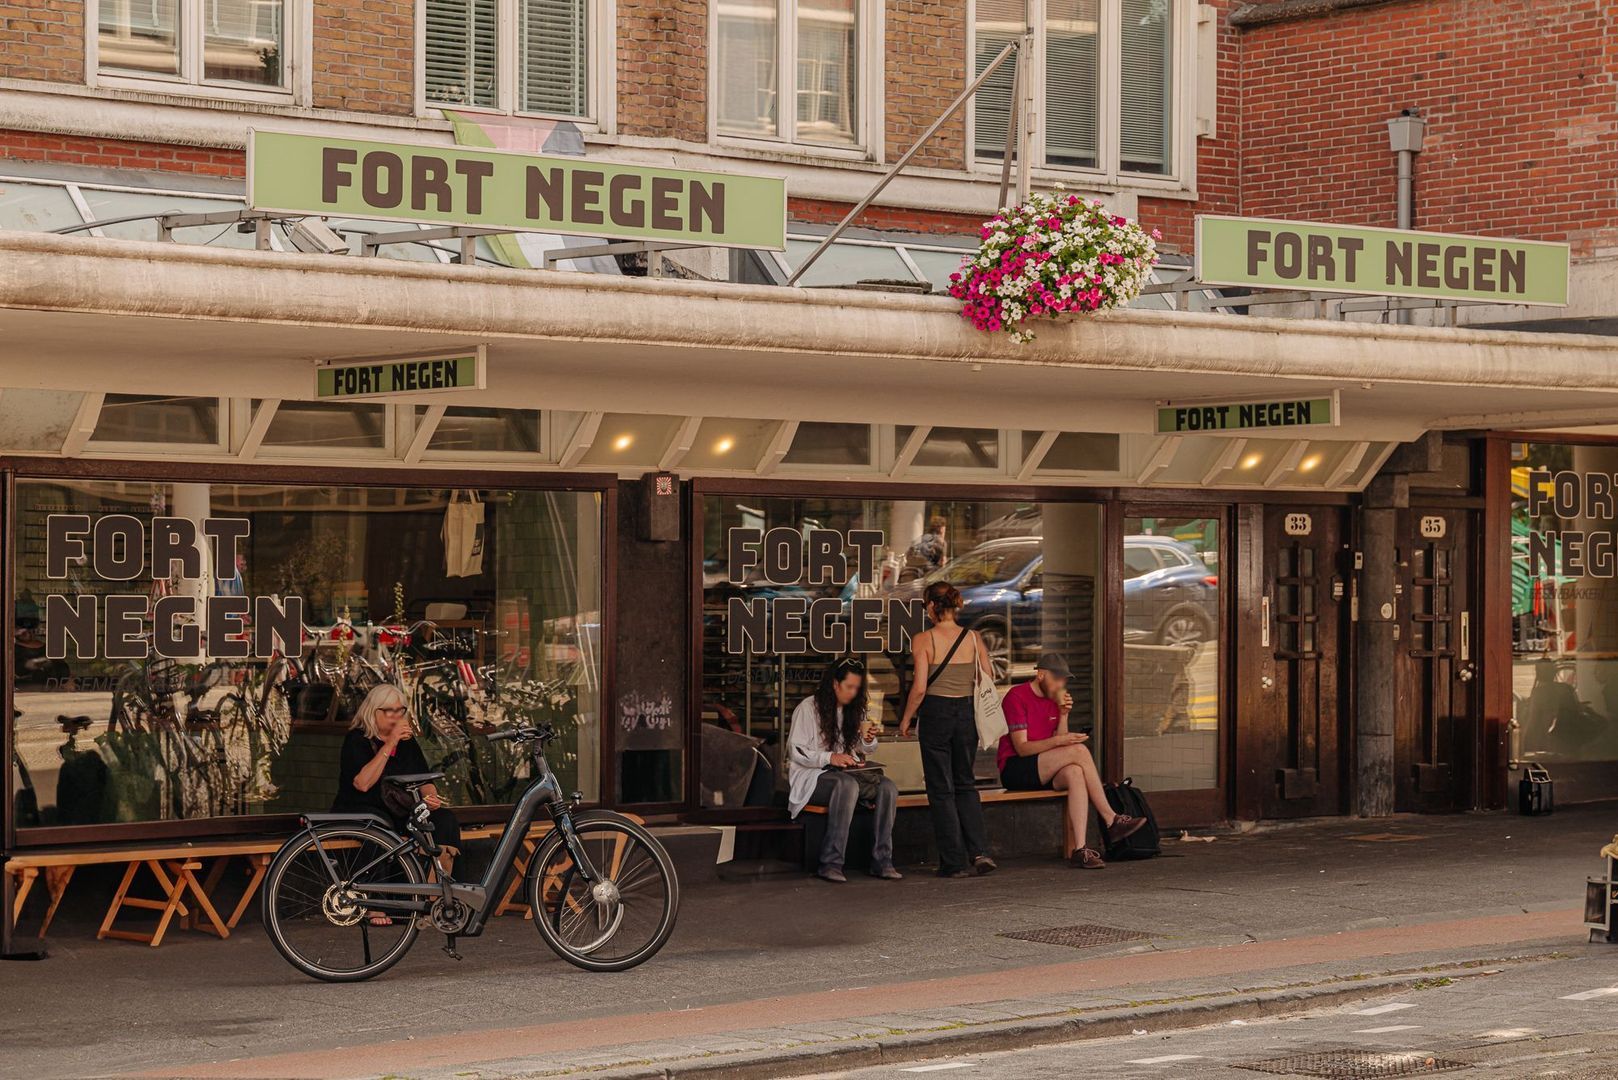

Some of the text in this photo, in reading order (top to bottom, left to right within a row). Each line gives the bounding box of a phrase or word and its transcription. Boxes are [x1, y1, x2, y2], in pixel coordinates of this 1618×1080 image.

[322, 148, 725, 234] FORT NEGEN
[1247, 231, 1525, 293] FORT NEGEN
[333, 360, 458, 395] FORT NEGEN
[1176, 401, 1311, 430] FORT NEGEN
[1529, 470, 1618, 520] FOR
[47, 515, 250, 580] FORT
[1290, 516, 1307, 531] 33
[1425, 519, 1441, 533] 35
[728, 527, 884, 585] FORT
[1529, 531, 1618, 579] NEG
[47, 595, 302, 658] NEGEN
[728, 598, 925, 653] NEGEN
